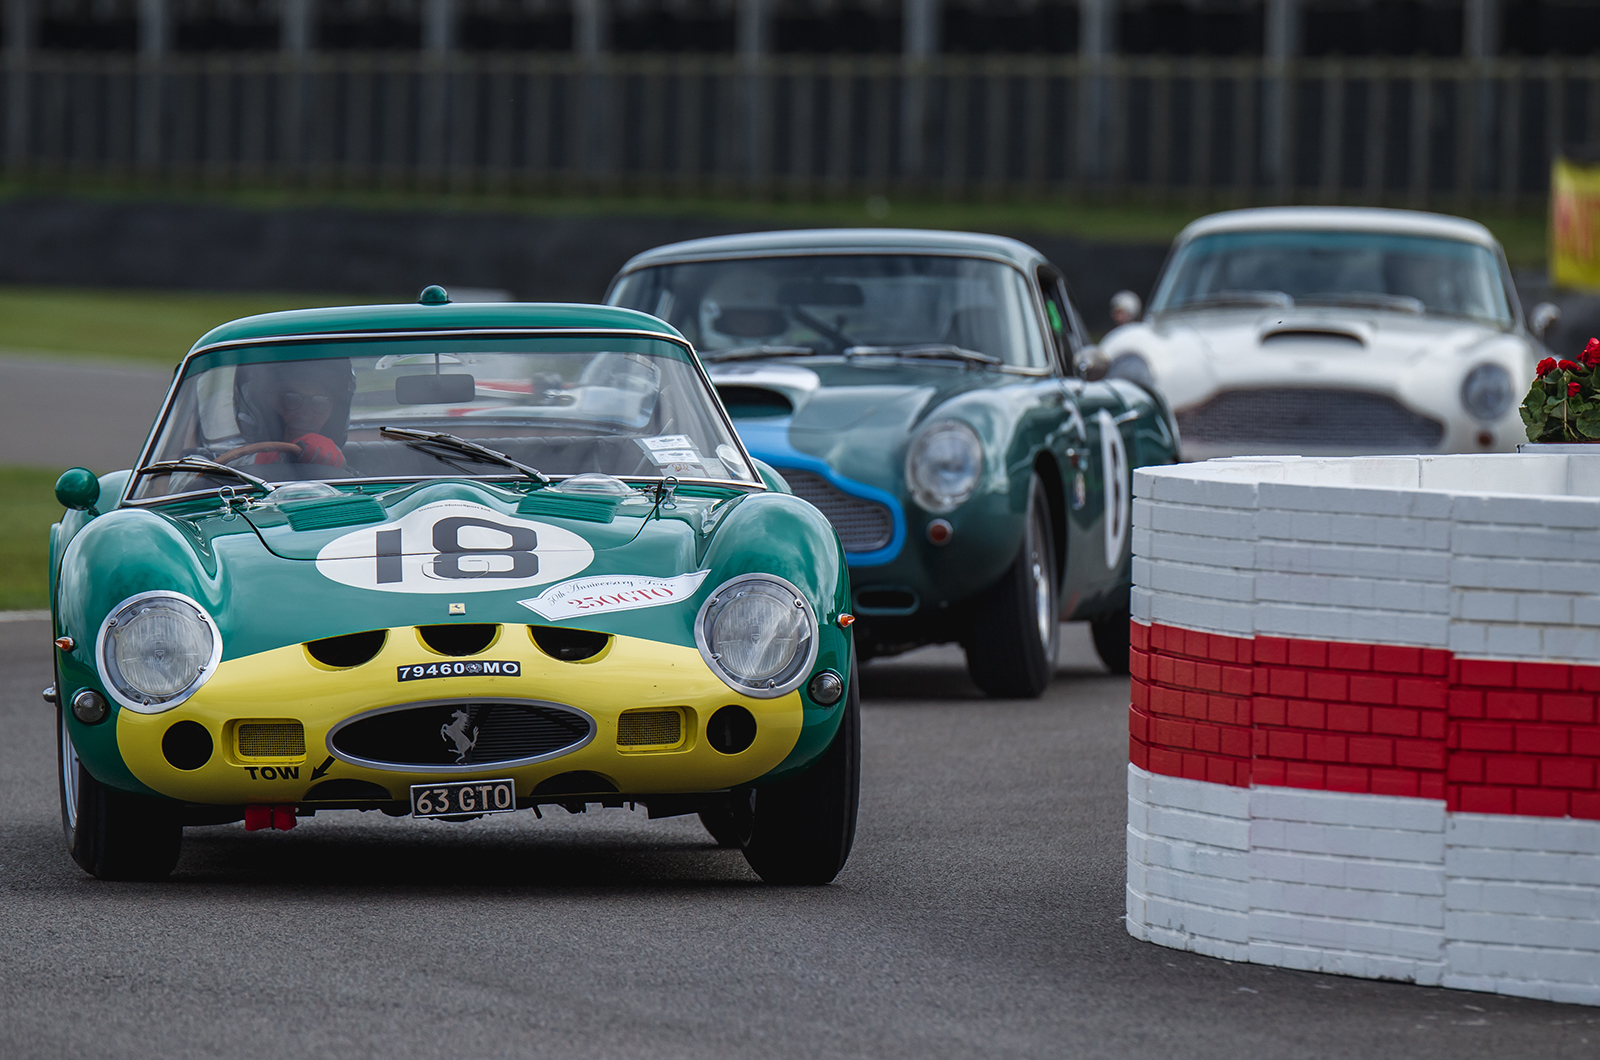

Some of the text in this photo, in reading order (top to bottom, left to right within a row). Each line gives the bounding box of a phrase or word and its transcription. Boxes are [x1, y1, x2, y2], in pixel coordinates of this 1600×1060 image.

[376, 516, 539, 585] 18
[547, 590, 566, 607] 50th
[565, 581, 634, 593] Anniversary
[567, 586, 674, 610] 250GTO
[399, 661, 519, 679] 79460 MO
[244, 766, 300, 781] TOW
[416, 784, 511, 814] 63 GTO
